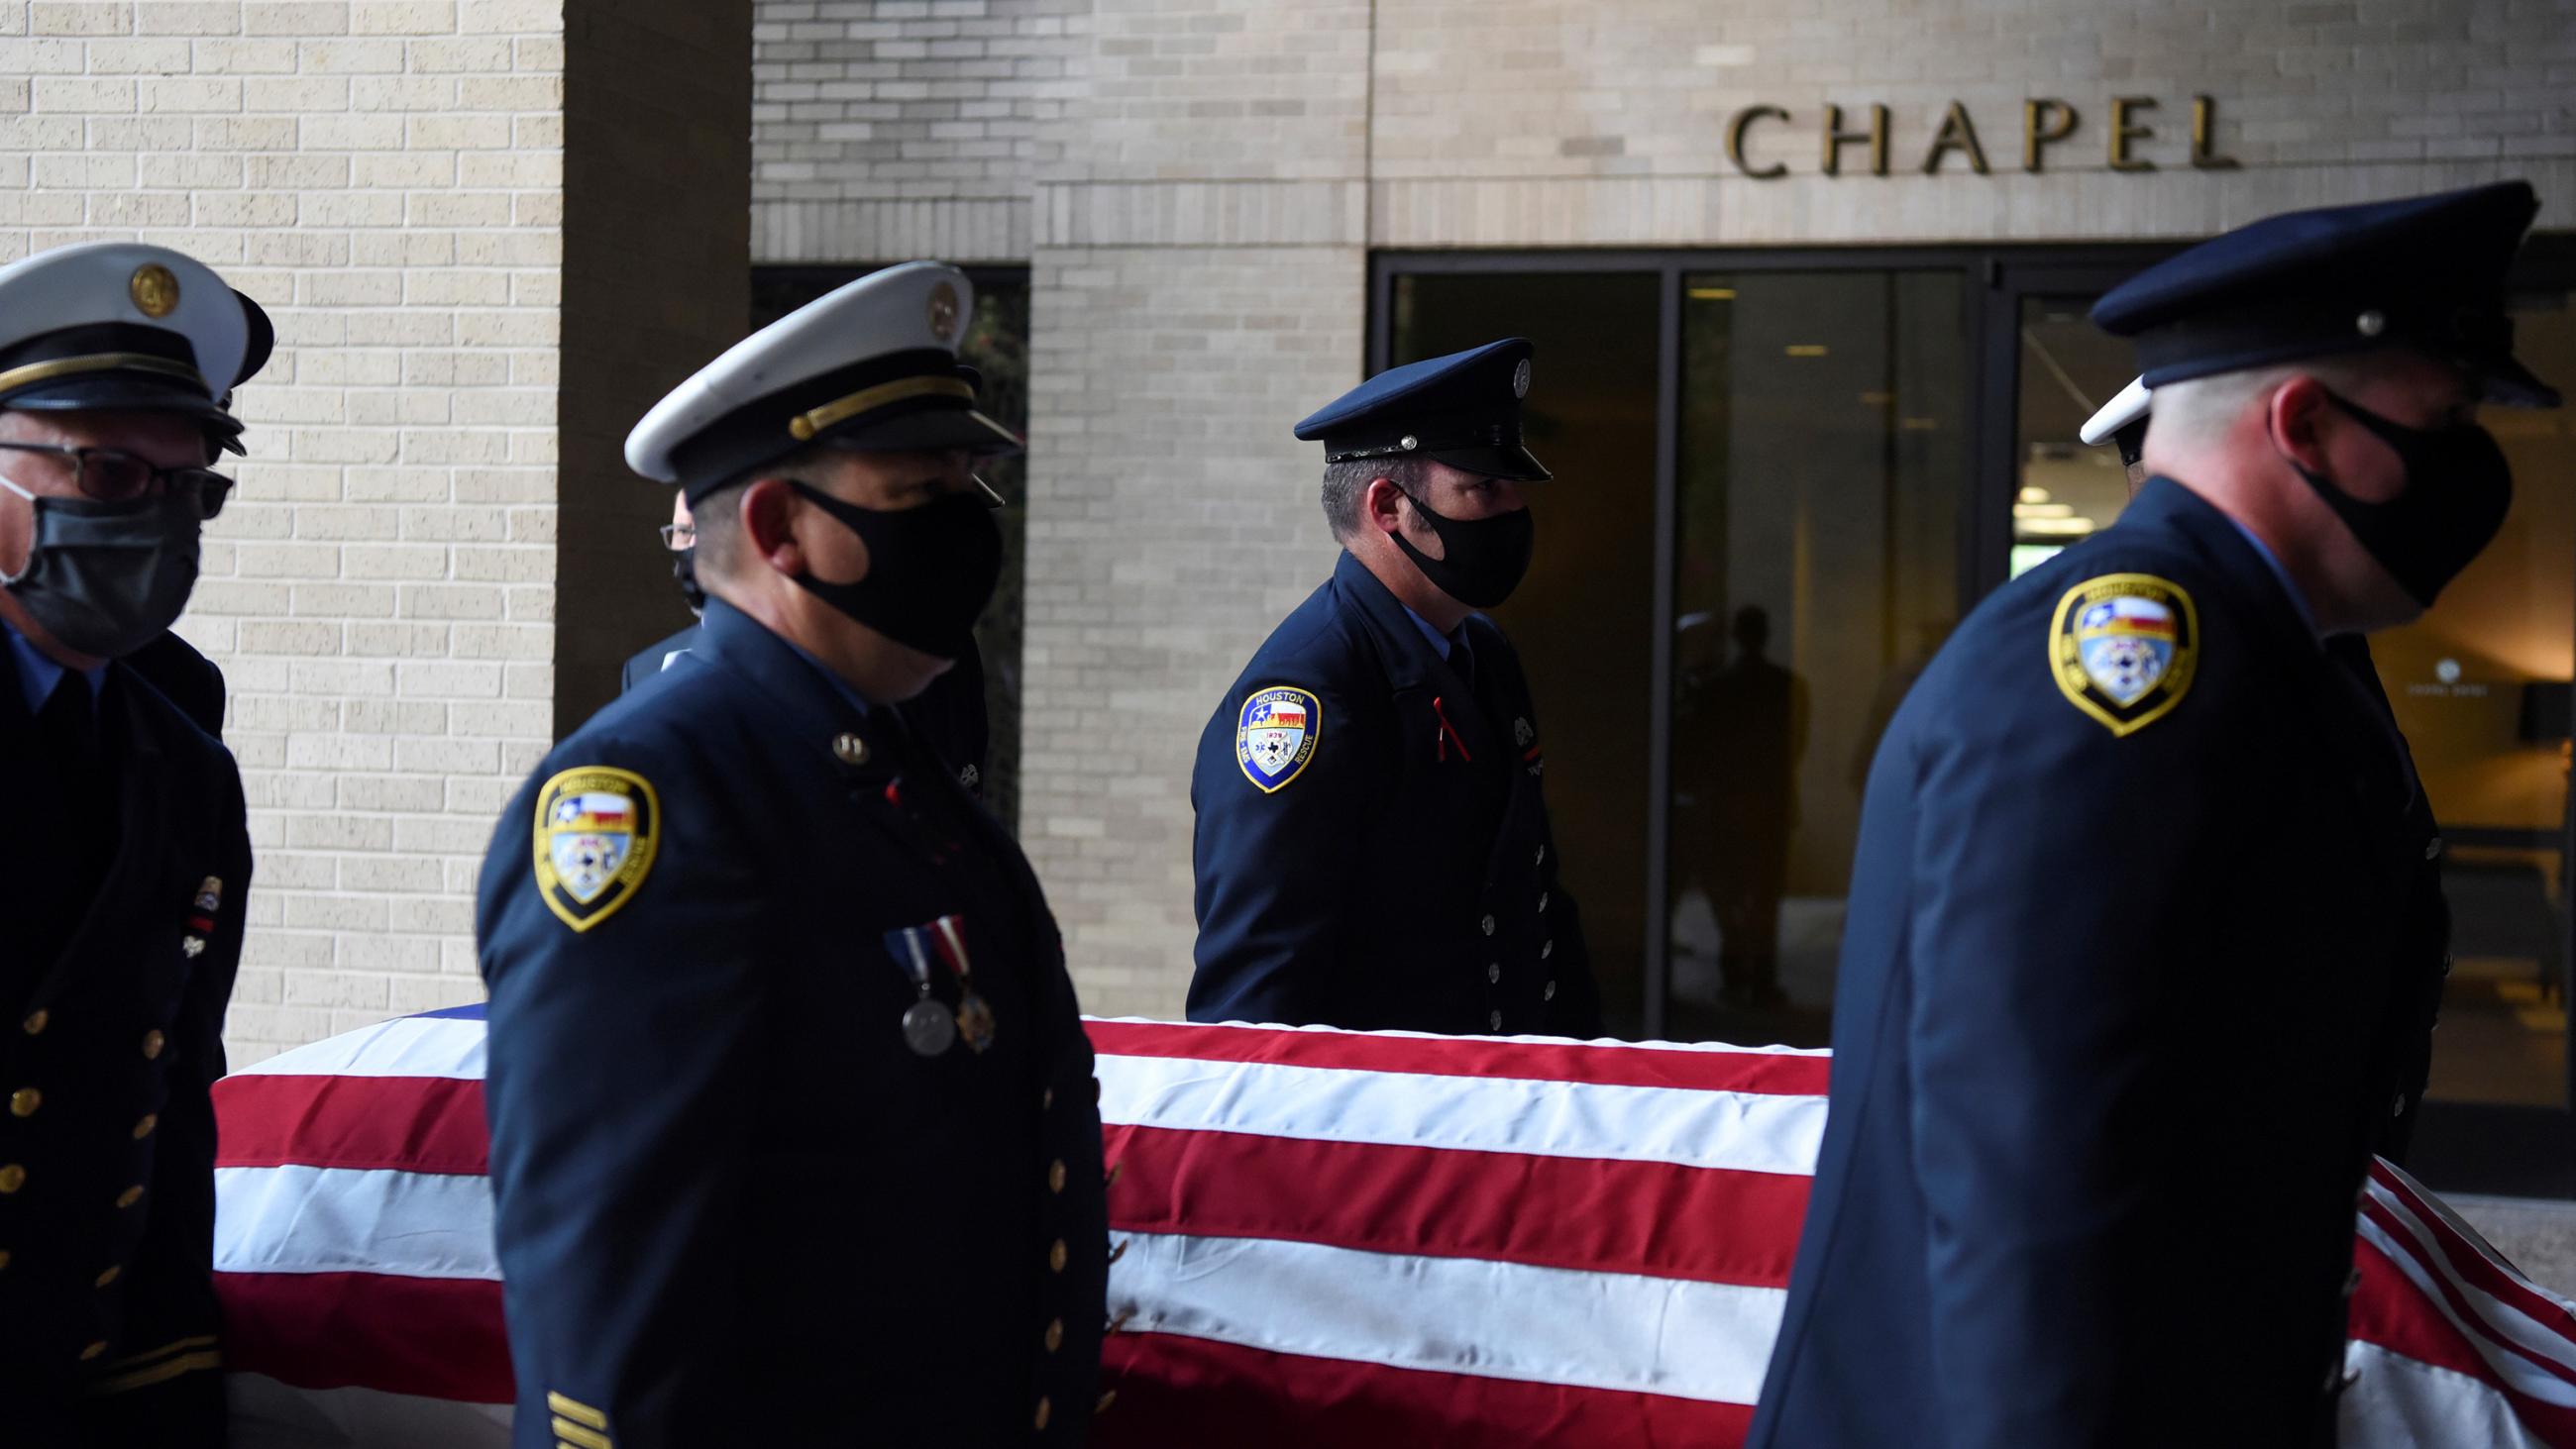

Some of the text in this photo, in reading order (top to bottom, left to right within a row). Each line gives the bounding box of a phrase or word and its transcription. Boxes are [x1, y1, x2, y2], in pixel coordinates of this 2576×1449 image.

[1724, 93, 2242, 179] CHAPEL
[1255, 691, 1305, 706] HOUSTON
[1294, 734, 1314, 765] RESCUE
